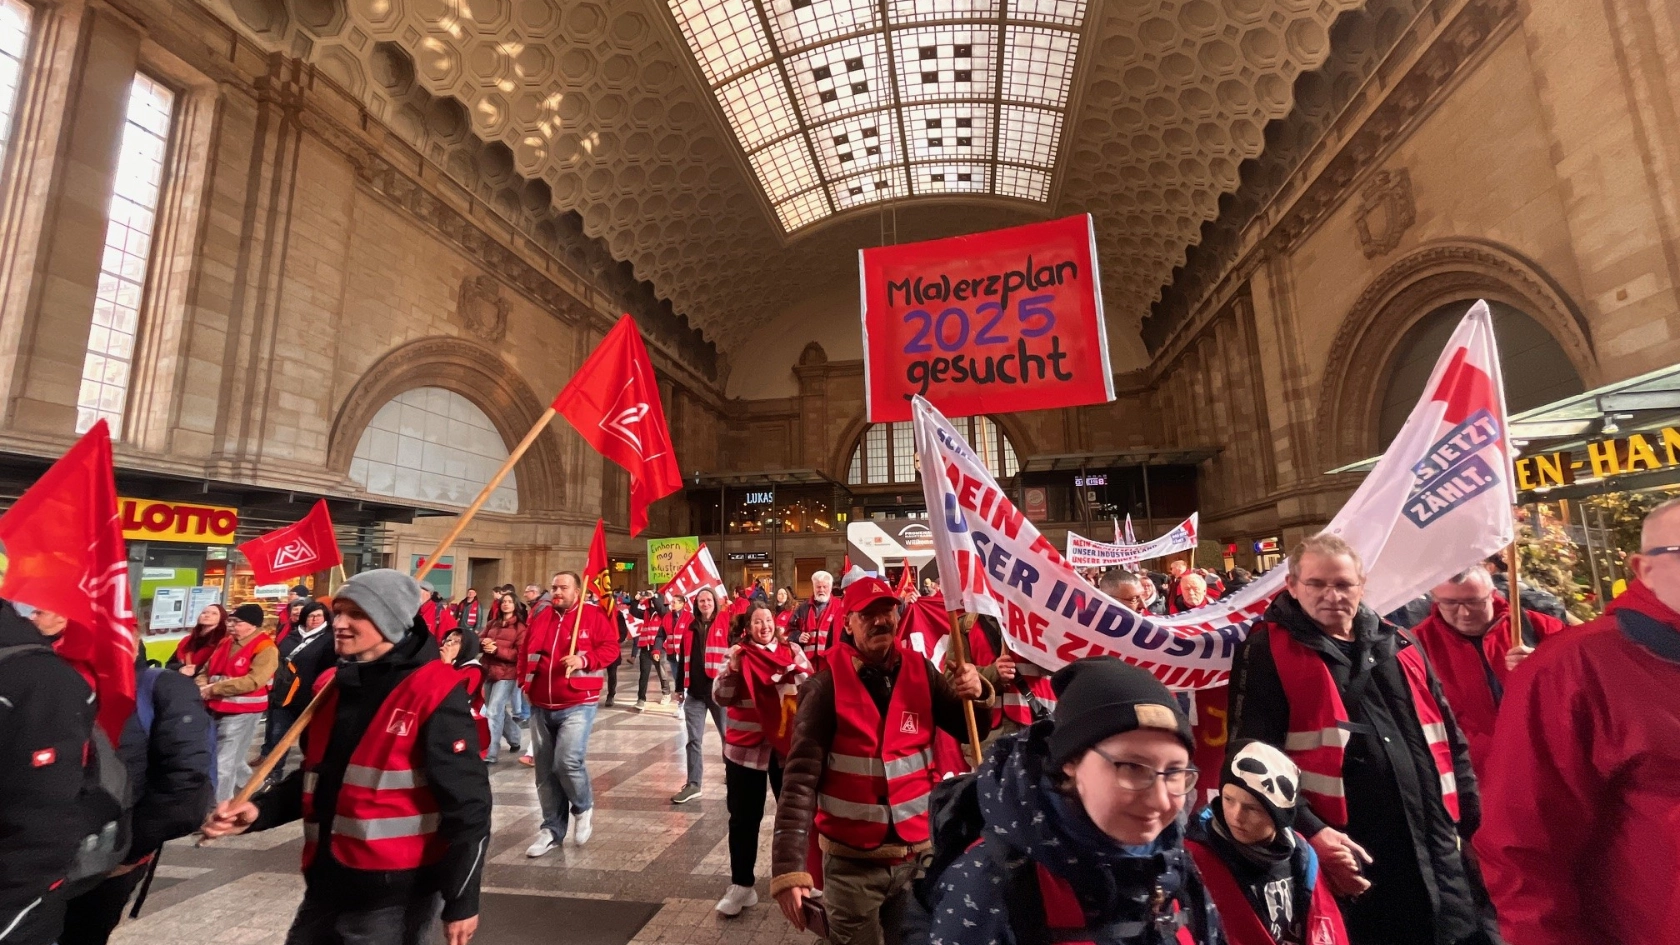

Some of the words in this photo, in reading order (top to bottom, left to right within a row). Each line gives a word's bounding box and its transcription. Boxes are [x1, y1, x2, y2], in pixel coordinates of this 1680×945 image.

[887, 254, 1077, 310] M(a)erzplan
[903, 294, 1056, 354] 2025
[903, 335, 1073, 401] gesucht
[1431, 416, 1496, 470] JETZT
[121, 500, 238, 537] LOTTO
[746, 492, 773, 504] LUKAS
[1410, 466, 1492, 522] ZÄHLT.
[1071, 556, 1101, 565] UNSERE
[1072, 547, 1096, 557] UNSER
